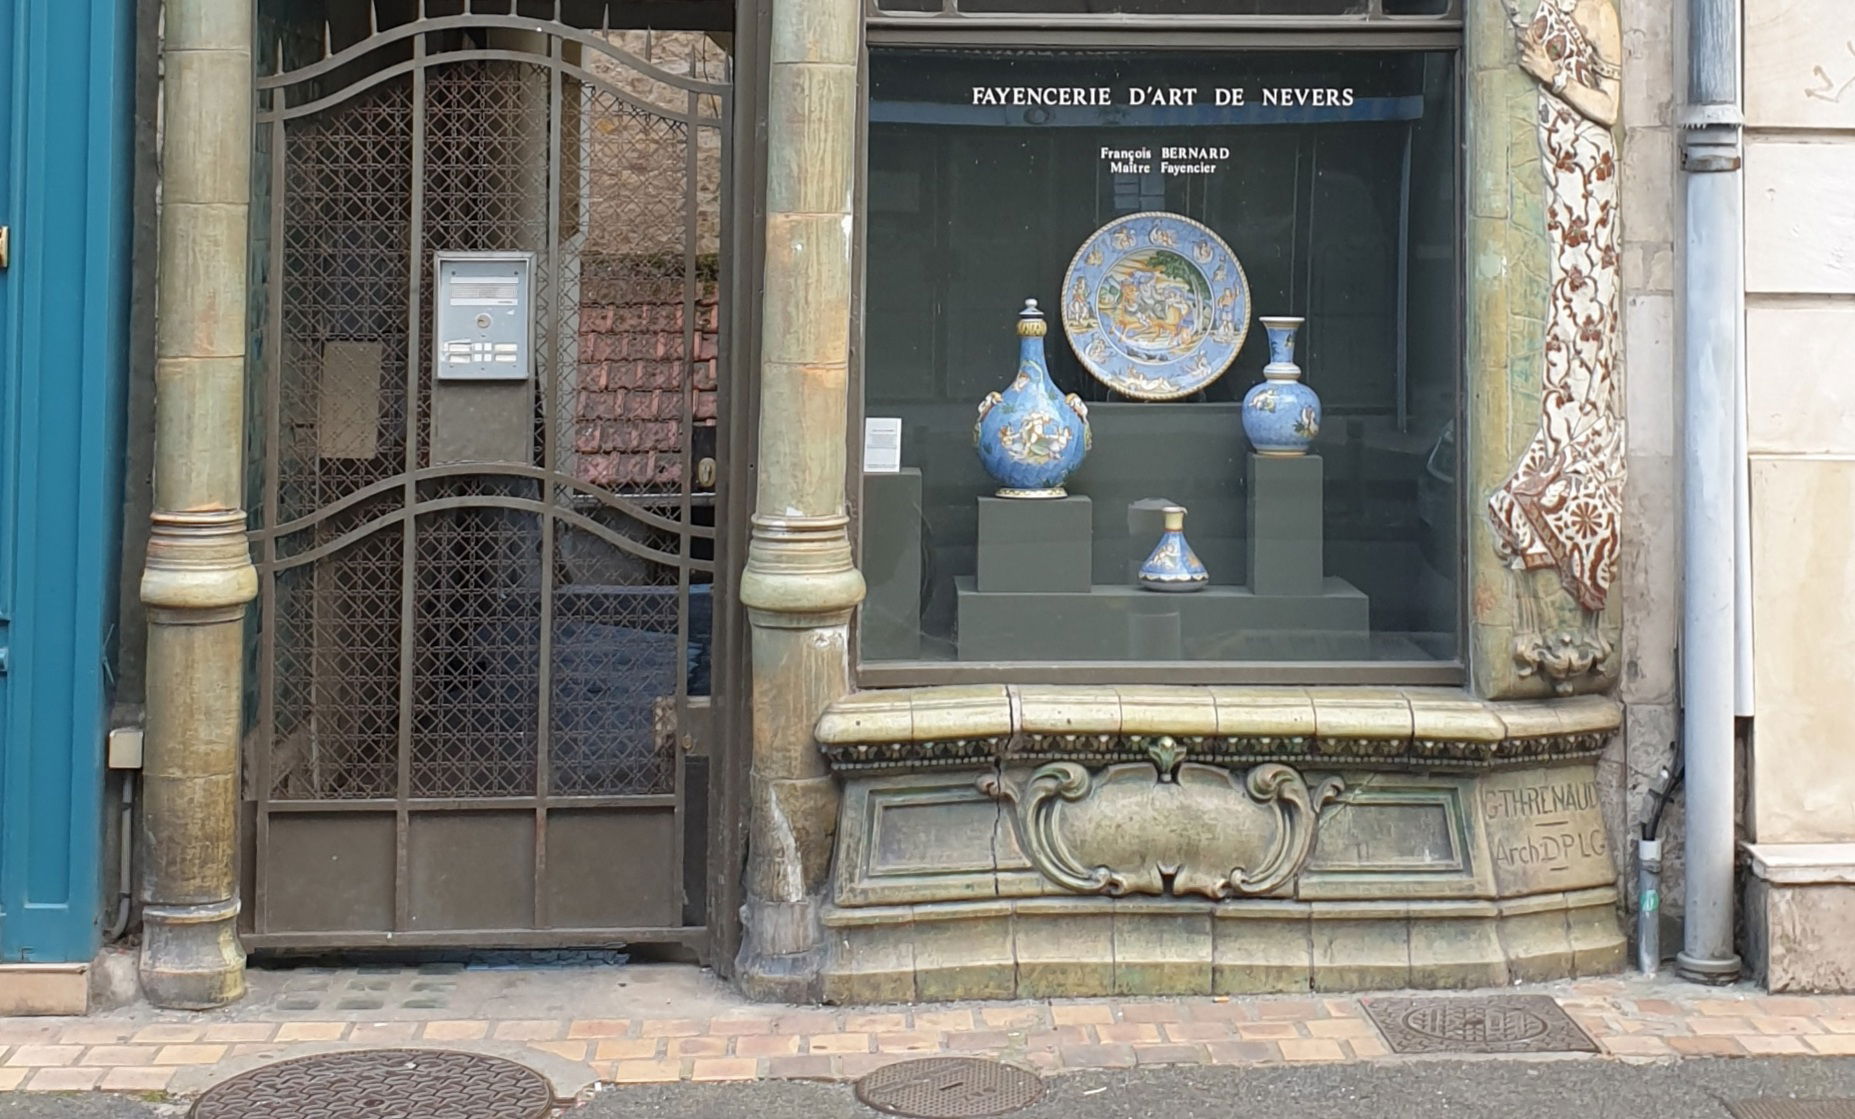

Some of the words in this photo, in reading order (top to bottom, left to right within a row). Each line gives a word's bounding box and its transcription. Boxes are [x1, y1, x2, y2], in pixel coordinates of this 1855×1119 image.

[972, 87, 1111, 106] FAYENCERIE
[1129, 86, 1197, 106] D'ART
[1215, 88, 1244, 106] DE
[1262, 88, 1354, 106] NEVERS
[1101, 147, 1151, 162] François
[1161, 147, 1230, 160] BERNARD
[1111, 161, 1151, 173] Maître
[1160, 161, 1217, 175] Fayencier
